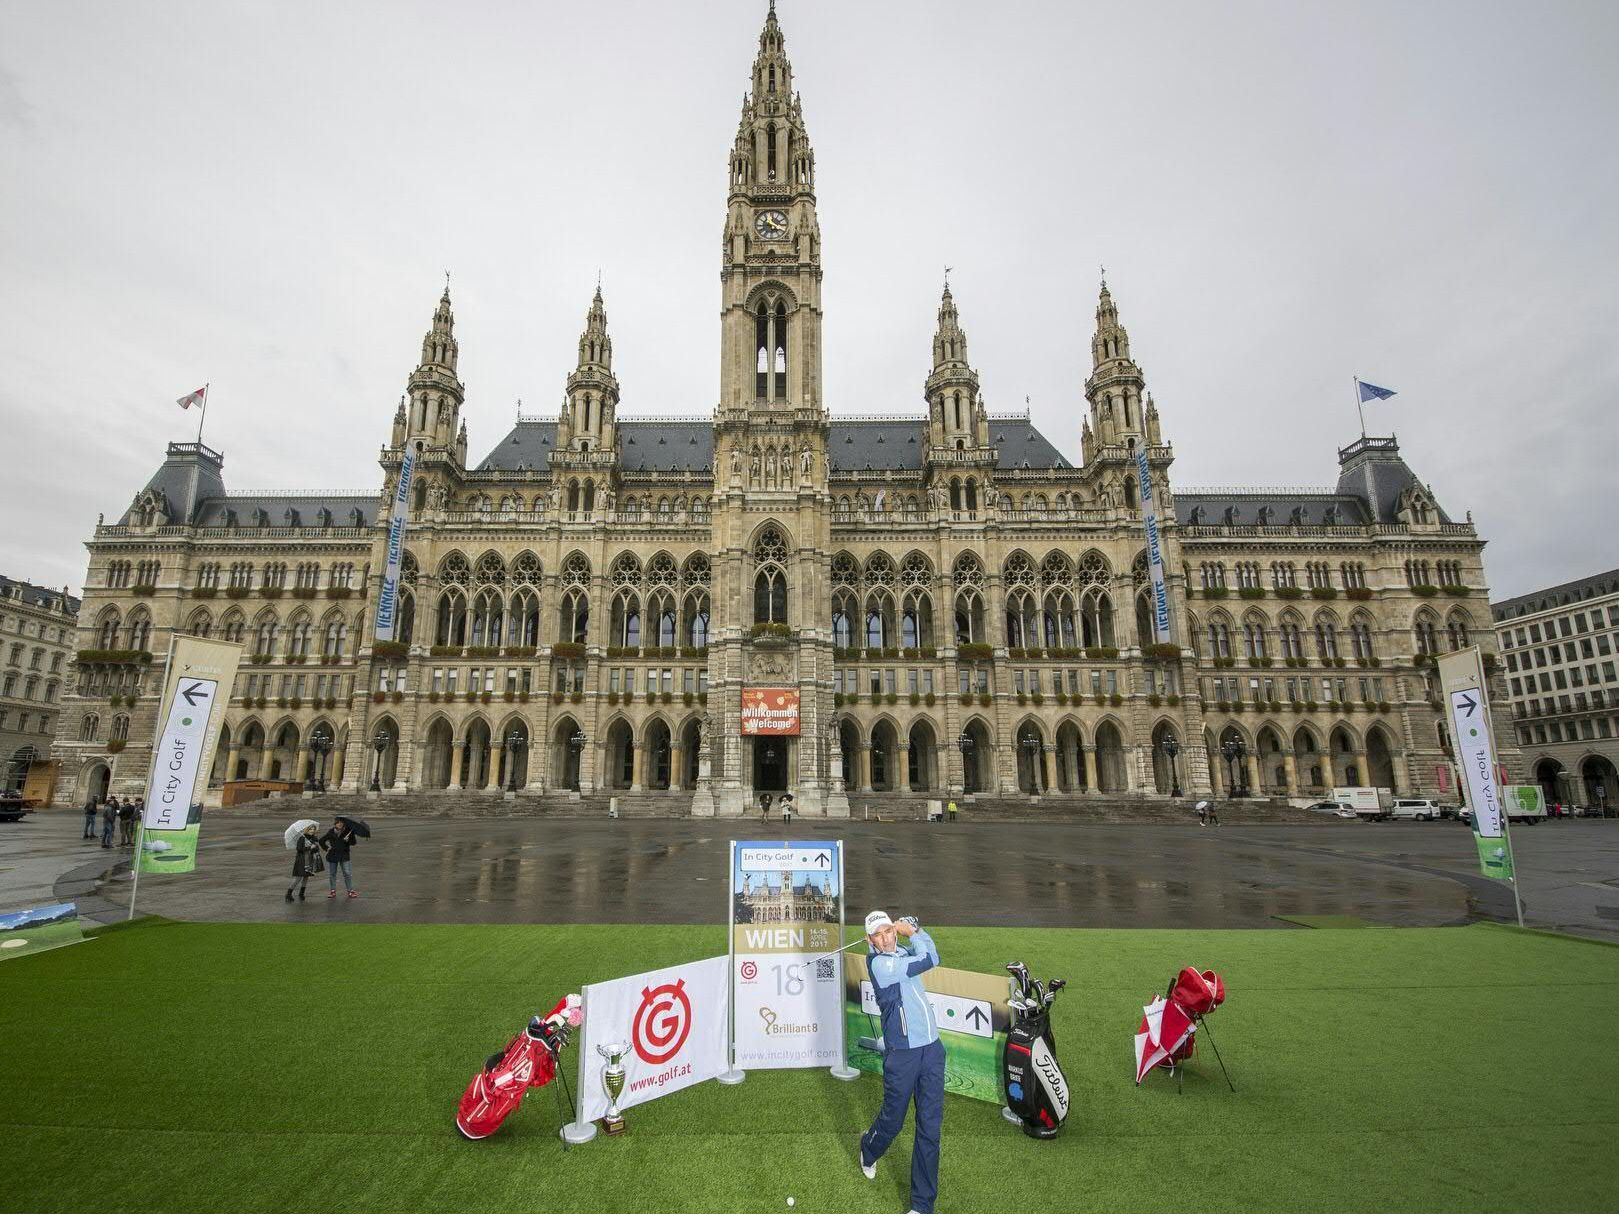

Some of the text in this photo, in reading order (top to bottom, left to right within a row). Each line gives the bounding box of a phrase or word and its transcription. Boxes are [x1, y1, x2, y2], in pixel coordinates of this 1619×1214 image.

[377, 577, 394, 629] VIENNALE
[742, 708, 798, 717] Willkommen
[750, 719, 791, 728] Welcome
[158, 738, 187, 824] In City Golf
[758, 853, 771, 862] City
[745, 928, 804, 948] WIEN
[771, 963, 804, 996] 18
[741, 1049, 838, 1060] www.incitygolf.com
[630, 1063, 692, 1092] www.golf.at
[1036, 1054, 1068, 1110] Titleist
